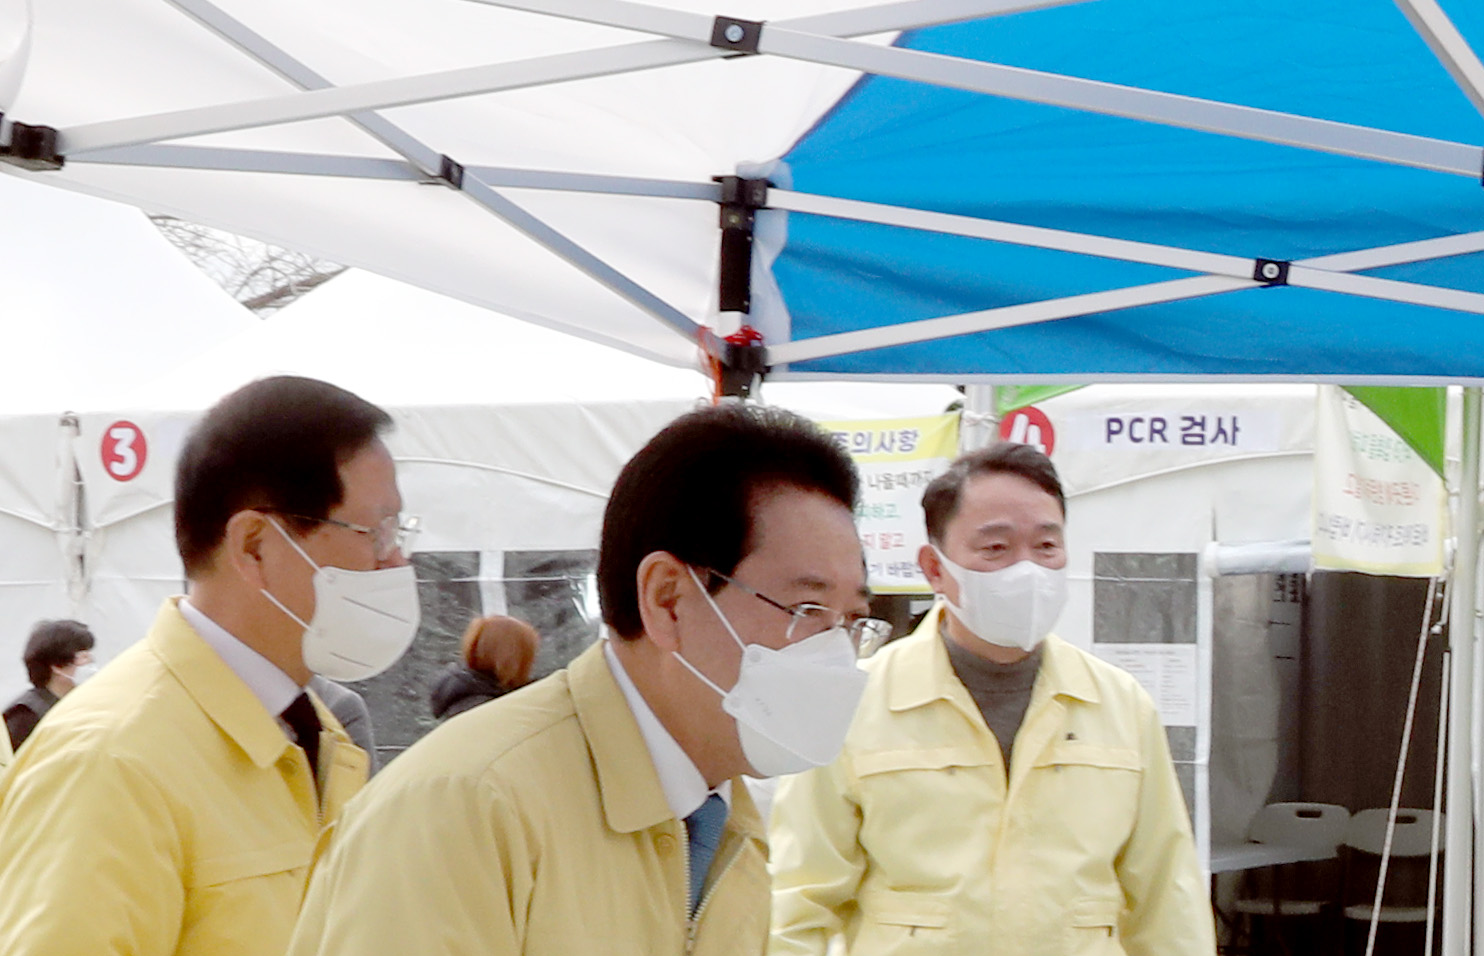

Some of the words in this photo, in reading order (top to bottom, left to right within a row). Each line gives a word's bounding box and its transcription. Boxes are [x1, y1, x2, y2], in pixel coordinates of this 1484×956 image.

[1106, 417, 1168, 443] PCR
[1180, 416, 1240, 446] 검사
[110, 428, 137, 476] 3
